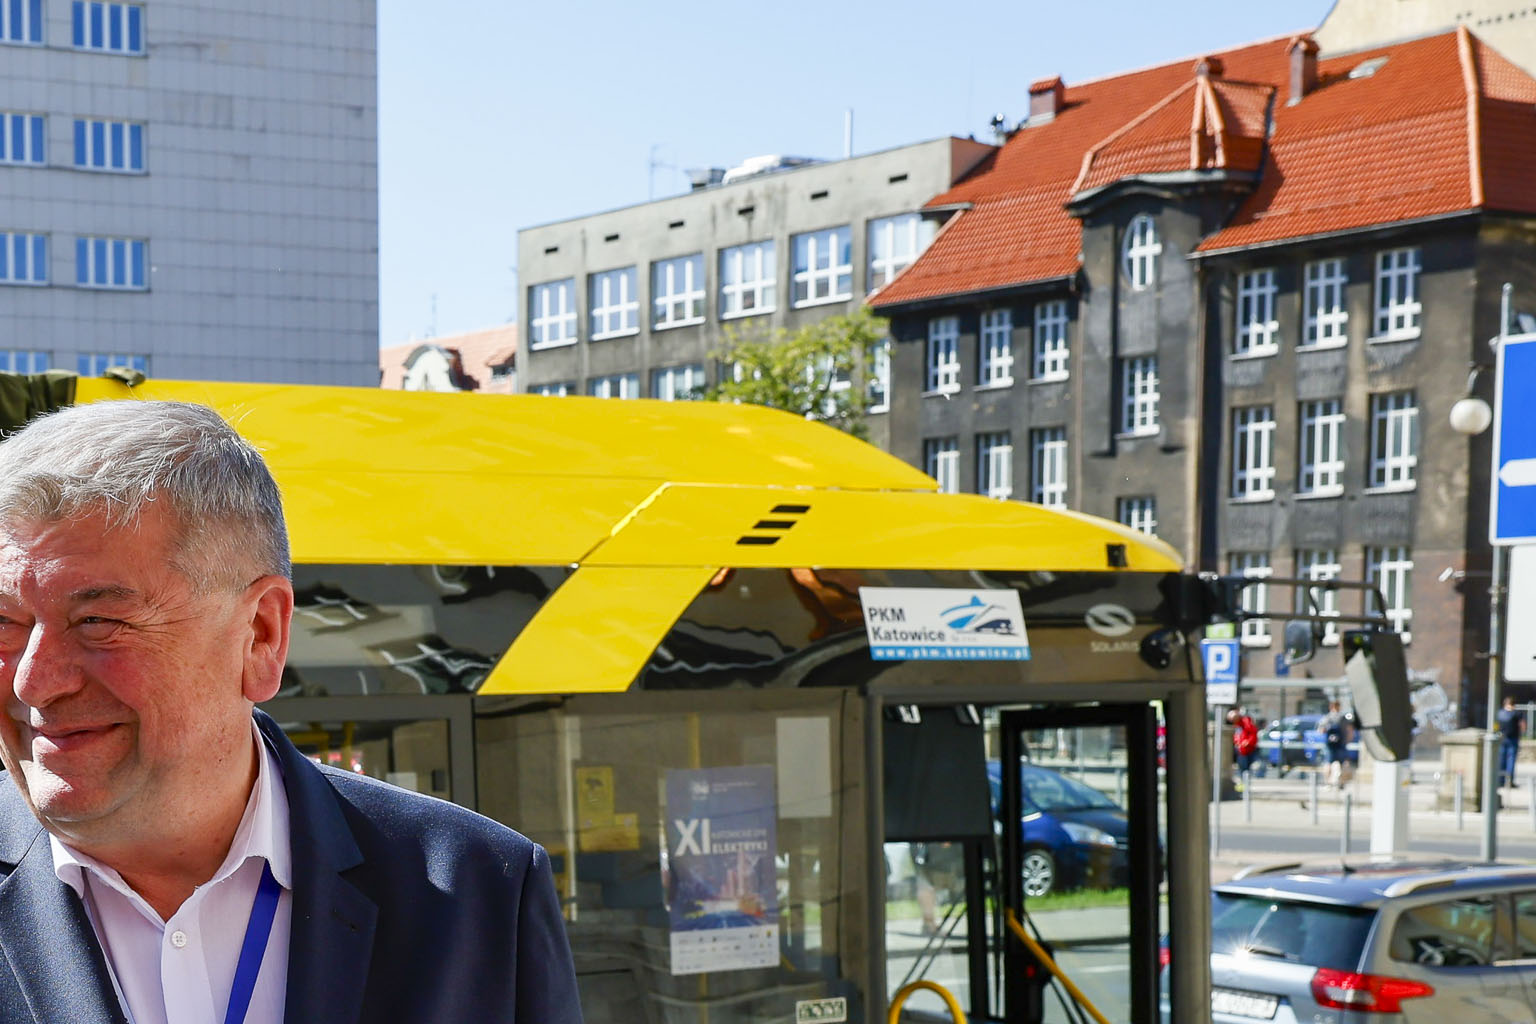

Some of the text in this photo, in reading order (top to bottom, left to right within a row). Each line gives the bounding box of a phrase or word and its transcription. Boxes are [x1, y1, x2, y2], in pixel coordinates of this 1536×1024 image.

[867, 606, 906, 623] PKM
[871, 626, 946, 642] Katowice
[1090, 640, 1140, 653] SOLARIS
[1206, 644, 1231, 680] P
[674, 817, 711, 857] XI
